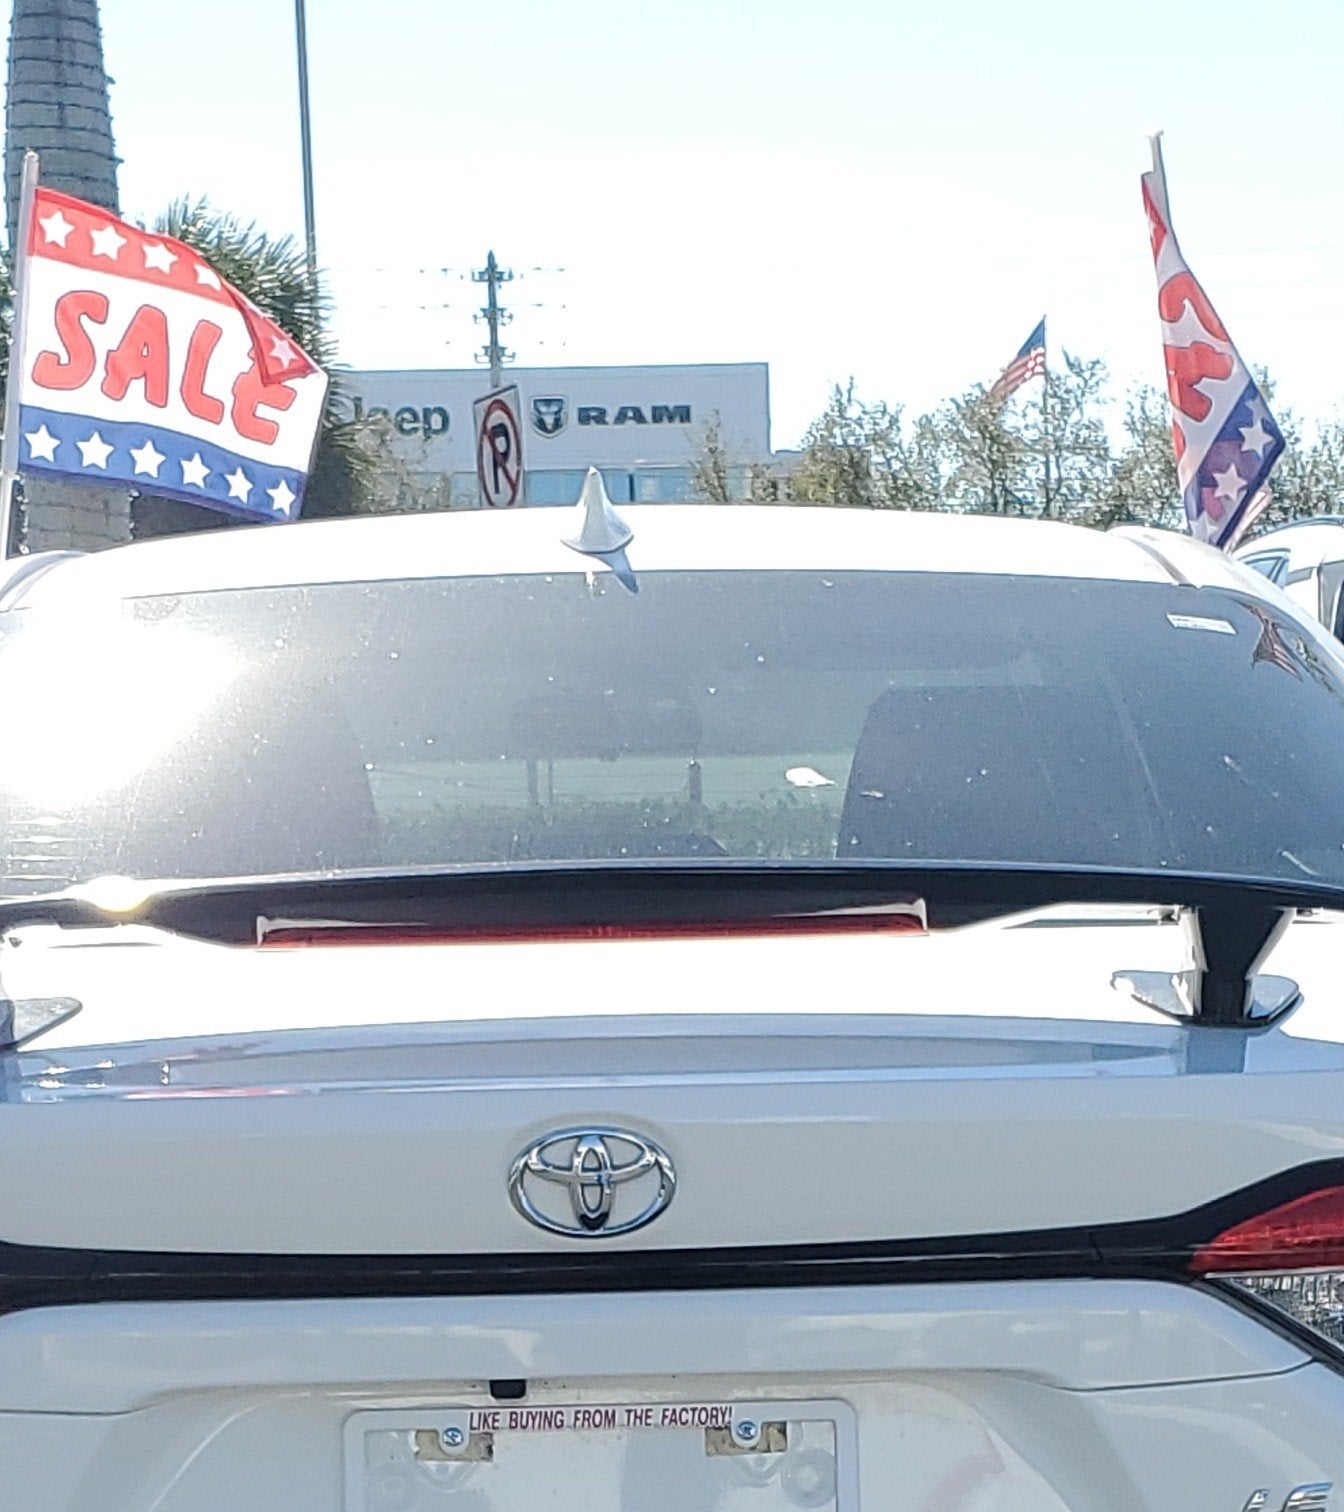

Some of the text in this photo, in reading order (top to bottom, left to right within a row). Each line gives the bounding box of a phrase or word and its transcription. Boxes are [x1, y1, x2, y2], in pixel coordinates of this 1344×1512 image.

[32, 290, 297, 445] SALE
[577, 404, 691, 426] RAM
[469, 1406, 733, 1431] LIKE BUYING FROM THE FACTORY!
